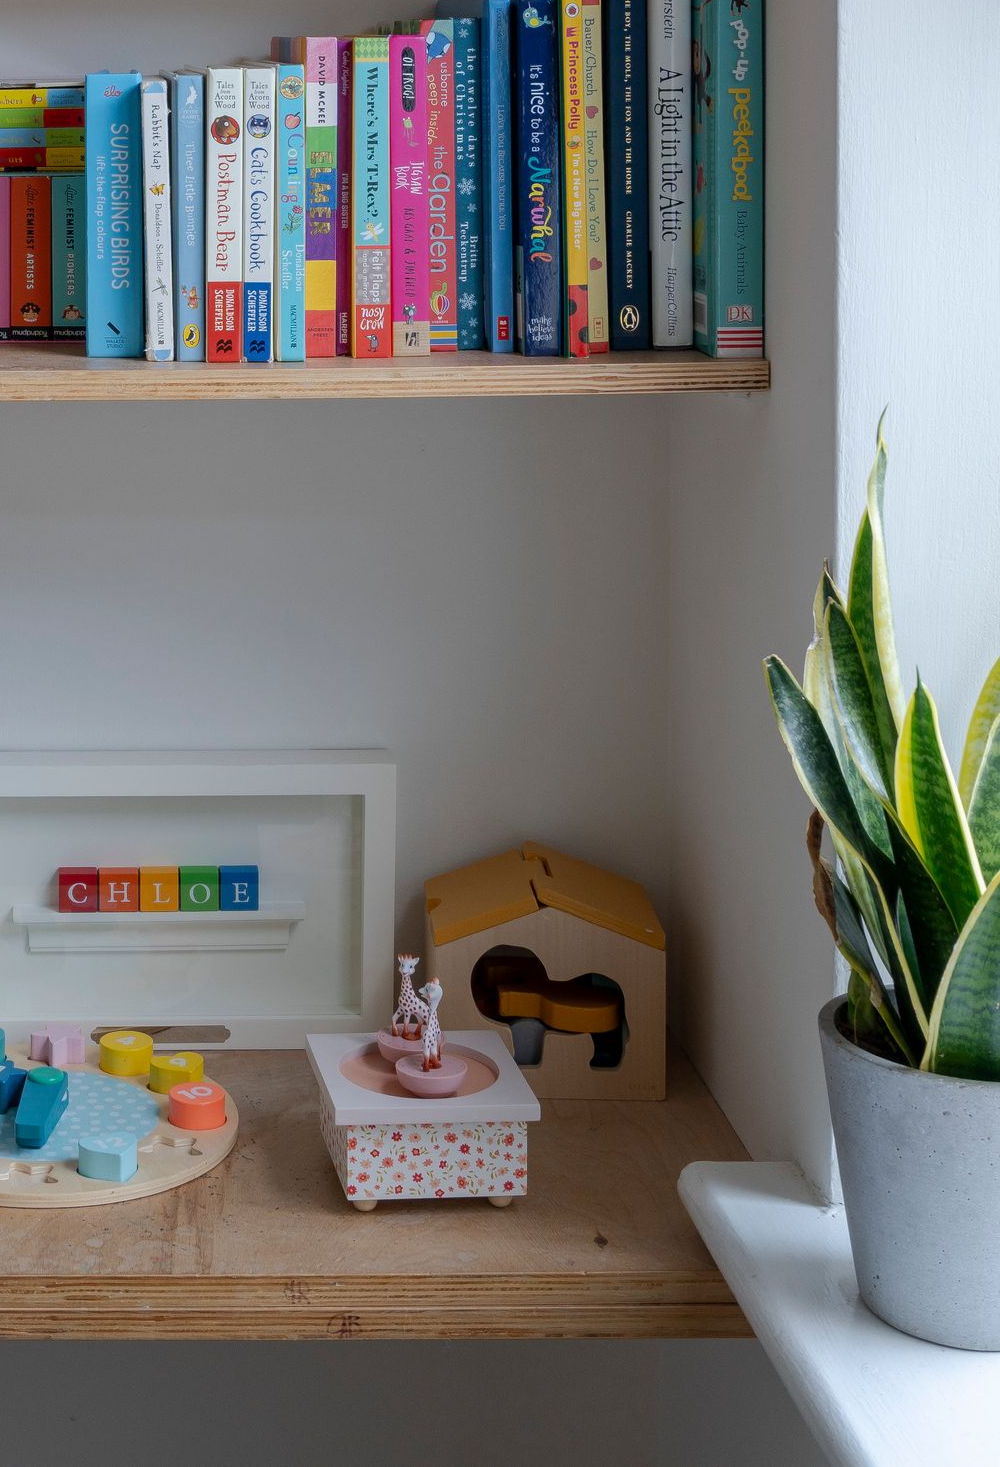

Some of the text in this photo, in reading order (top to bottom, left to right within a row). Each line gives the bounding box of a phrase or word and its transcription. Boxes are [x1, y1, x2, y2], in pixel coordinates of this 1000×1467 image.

[318, 56, 326, 86] DAVID
[440, 62, 450, 107] usborne
[530, 64, 542, 79] It's
[584, 18, 598, 96] Bauer/Church
[624, 56, 632, 82] MOLE,
[428, 74, 440, 145] peep inside
[456, 62, 466, 160] of Christmas
[466, 48, 477, 167] the twelve days
[530, 82, 550, 114] nice
[568, 41, 581, 130] Princess Polly
[150, 104, 162, 170] Rabbit's Nap
[366, 66, 378, 217] Where's Mrs T-Rex?
[531, 118, 542, 128] to
[532, 132, 544, 144] be
[586, 130, 597, 155] How
[728, 88, 754, 202] peekaboo!
[281, 134, 304, 202] Counting
[394, 166, 411, 190] BOOK
[410, 161, 424, 194] JIGSAW
[588, 160, 598, 174] Do
[654, 67, 684, 242] A Light in the Attic
[94, 156, 106, 260] lift-the-flap colours
[110, 124, 132, 290] SURPRISING BIRDS
[185, 142, 197, 246] Three Little Bunnies
[216, 152, 237, 272] Postman Bear
[249, 148, 268, 272] Cat's Cookbook
[310, 152, 333, 236] ELMER
[428, 146, 454, 272] the garden
[528, 156, 554, 262] Narwhal
[588, 188, 600, 212] Love
[26, 209, 34, 290] FEMINIST ARTISTS
[66, 208, 74, 296] FEMINIST PIONEERS
[155, 204, 164, 272] Donaldson Scheffler
[458, 222, 469, 282] Teckentrup
[470, 236, 478, 268] Britta
[589, 218, 600, 243] You?
[736, 210, 750, 294] Baby Animals
[370, 250, 383, 303] Felt Flaps
[665, 267, 678, 336] HarperCollins
[156, 302, 164, 339] MACMILLAN
[340, 312, 348, 344] HARPER
[360, 307, 384, 330] nosy crow
[528, 324, 555, 334] believe
[531, 316, 553, 326] make
[532, 334, 552, 342] ideas
[729, 306, 751, 320] DK
[68, 882, 250, 904] CHLOE
[177, 1086, 214, 1100] 10
